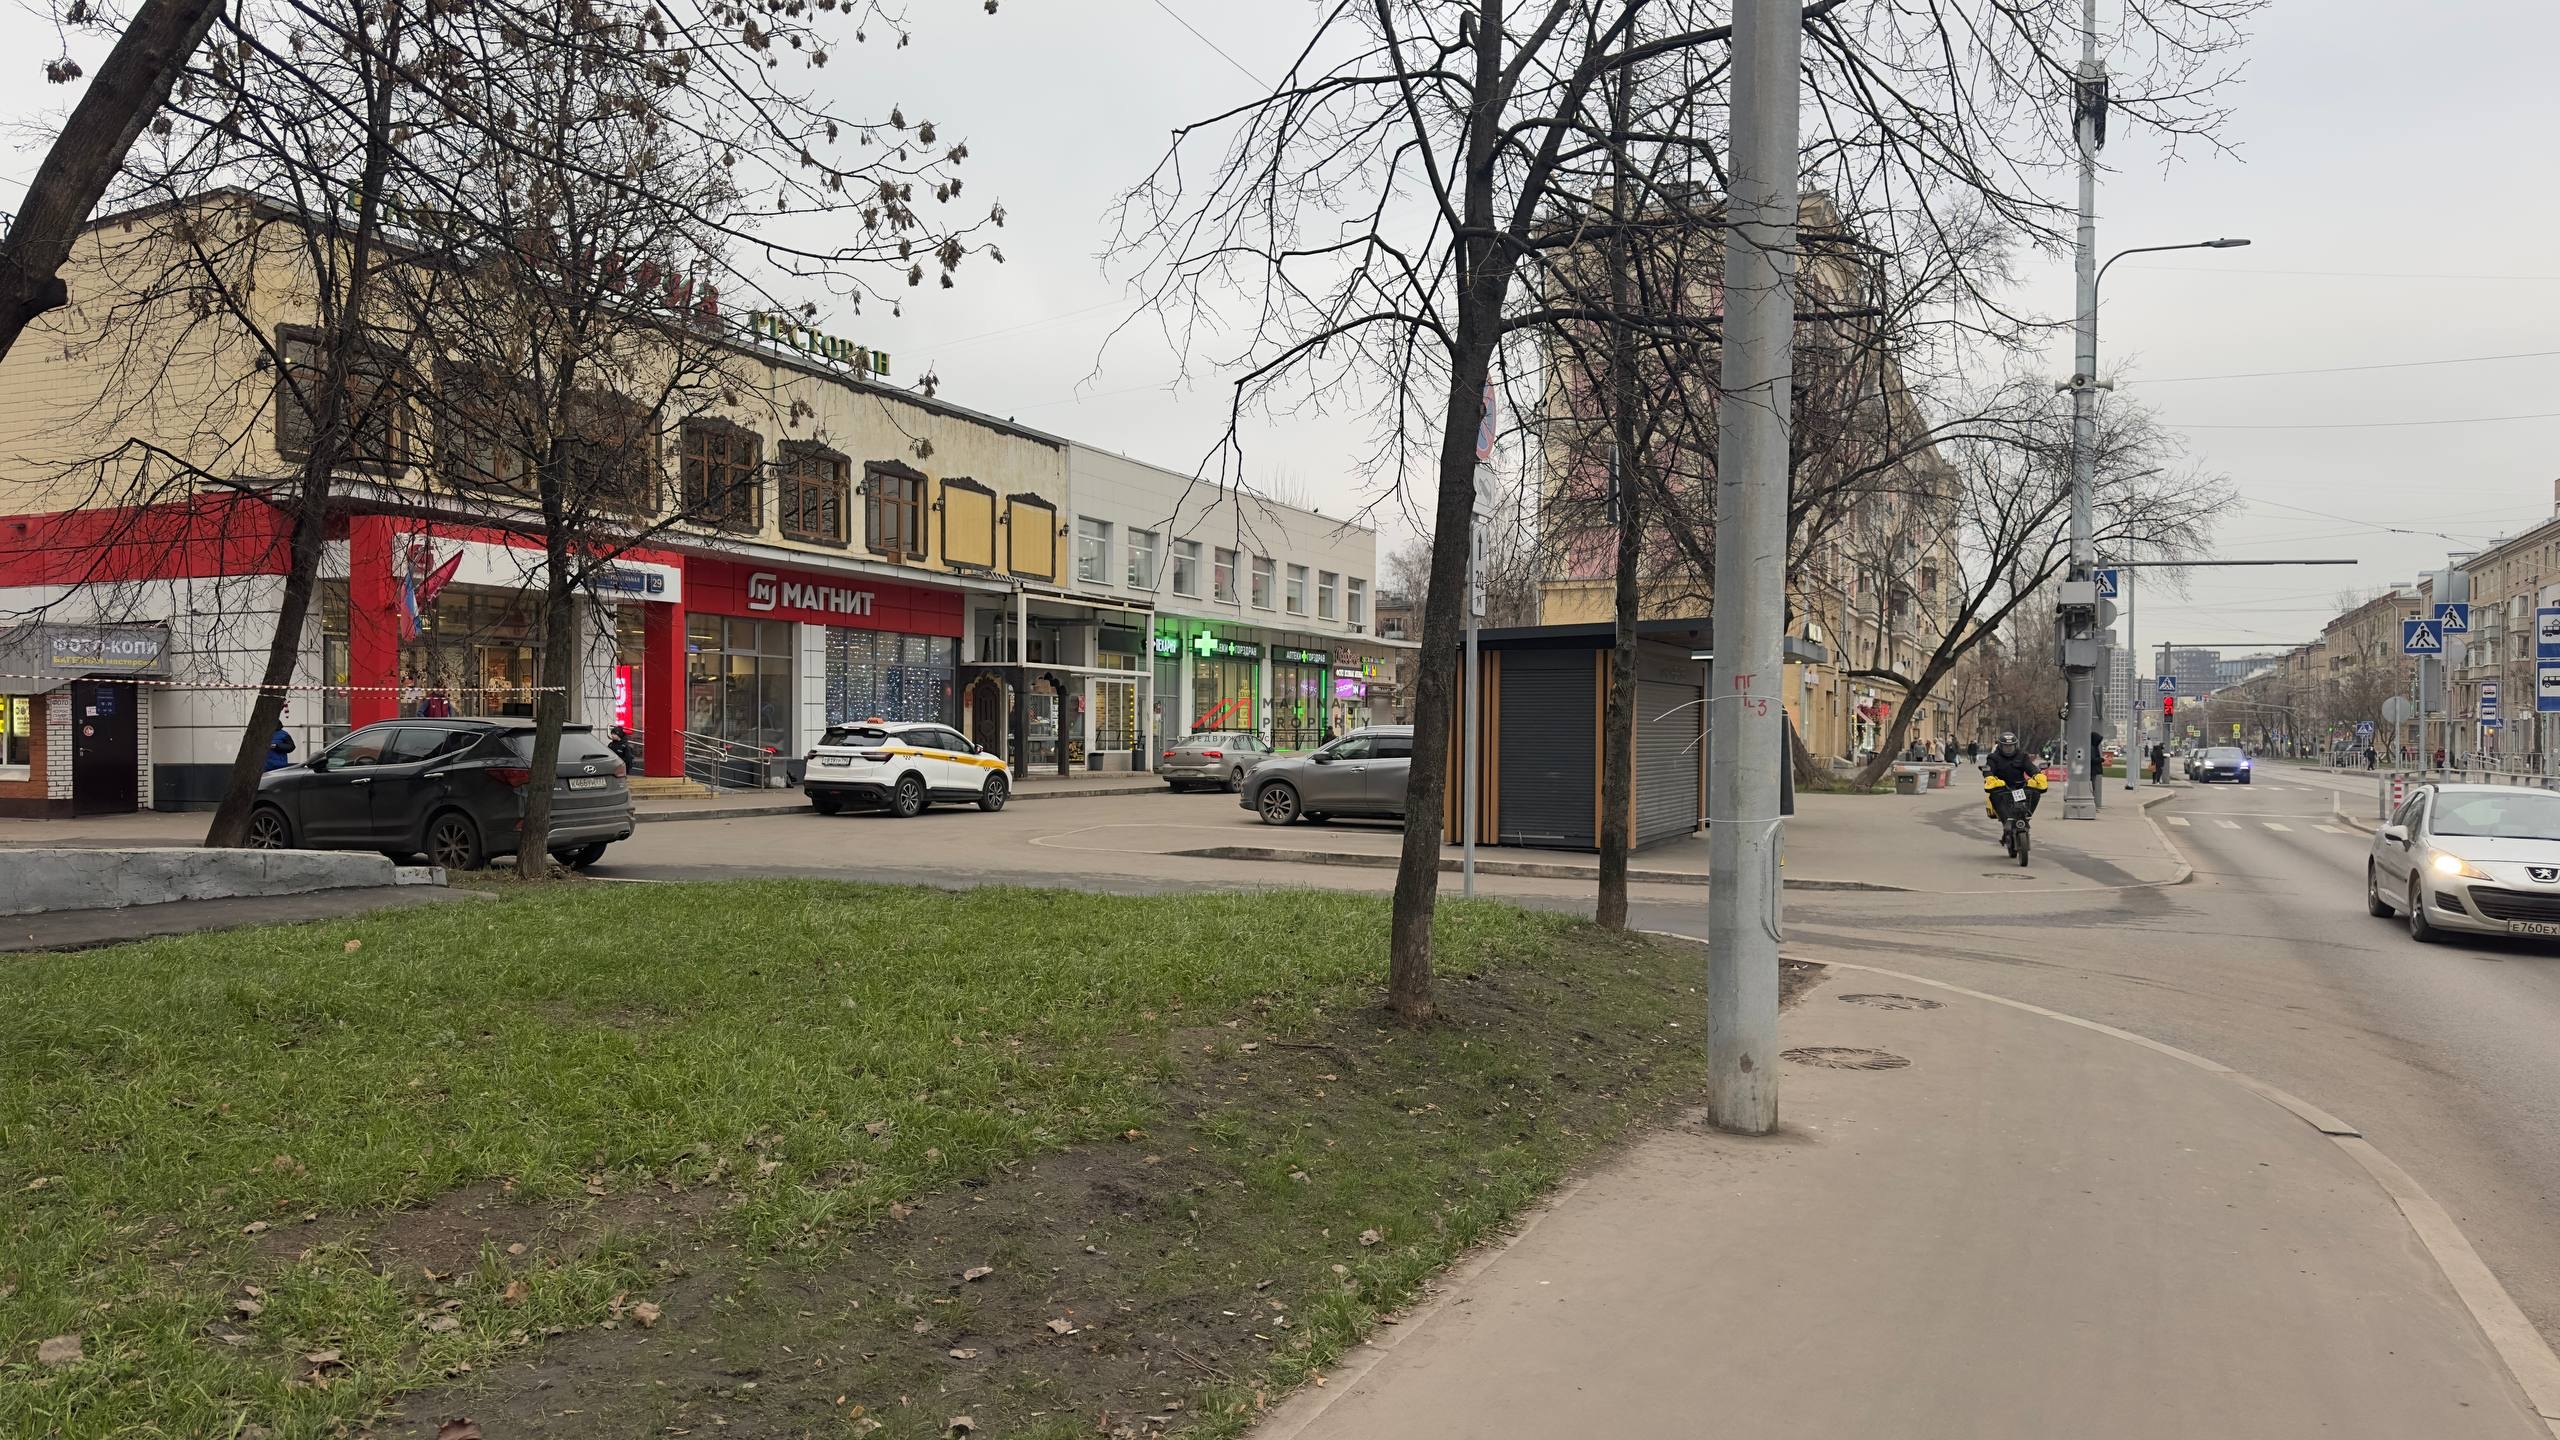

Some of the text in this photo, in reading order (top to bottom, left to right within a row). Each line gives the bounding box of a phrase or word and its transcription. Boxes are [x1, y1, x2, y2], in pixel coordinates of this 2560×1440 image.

[750, 310, 891, 376] РЕСТОРАН
[652, 577, 662, 588] 29
[1475, 570, 1484, 590] 20
[781, 582, 875, 615] МАГНИТ
[2512, 923, 2558, 935] Е760ЕХ
